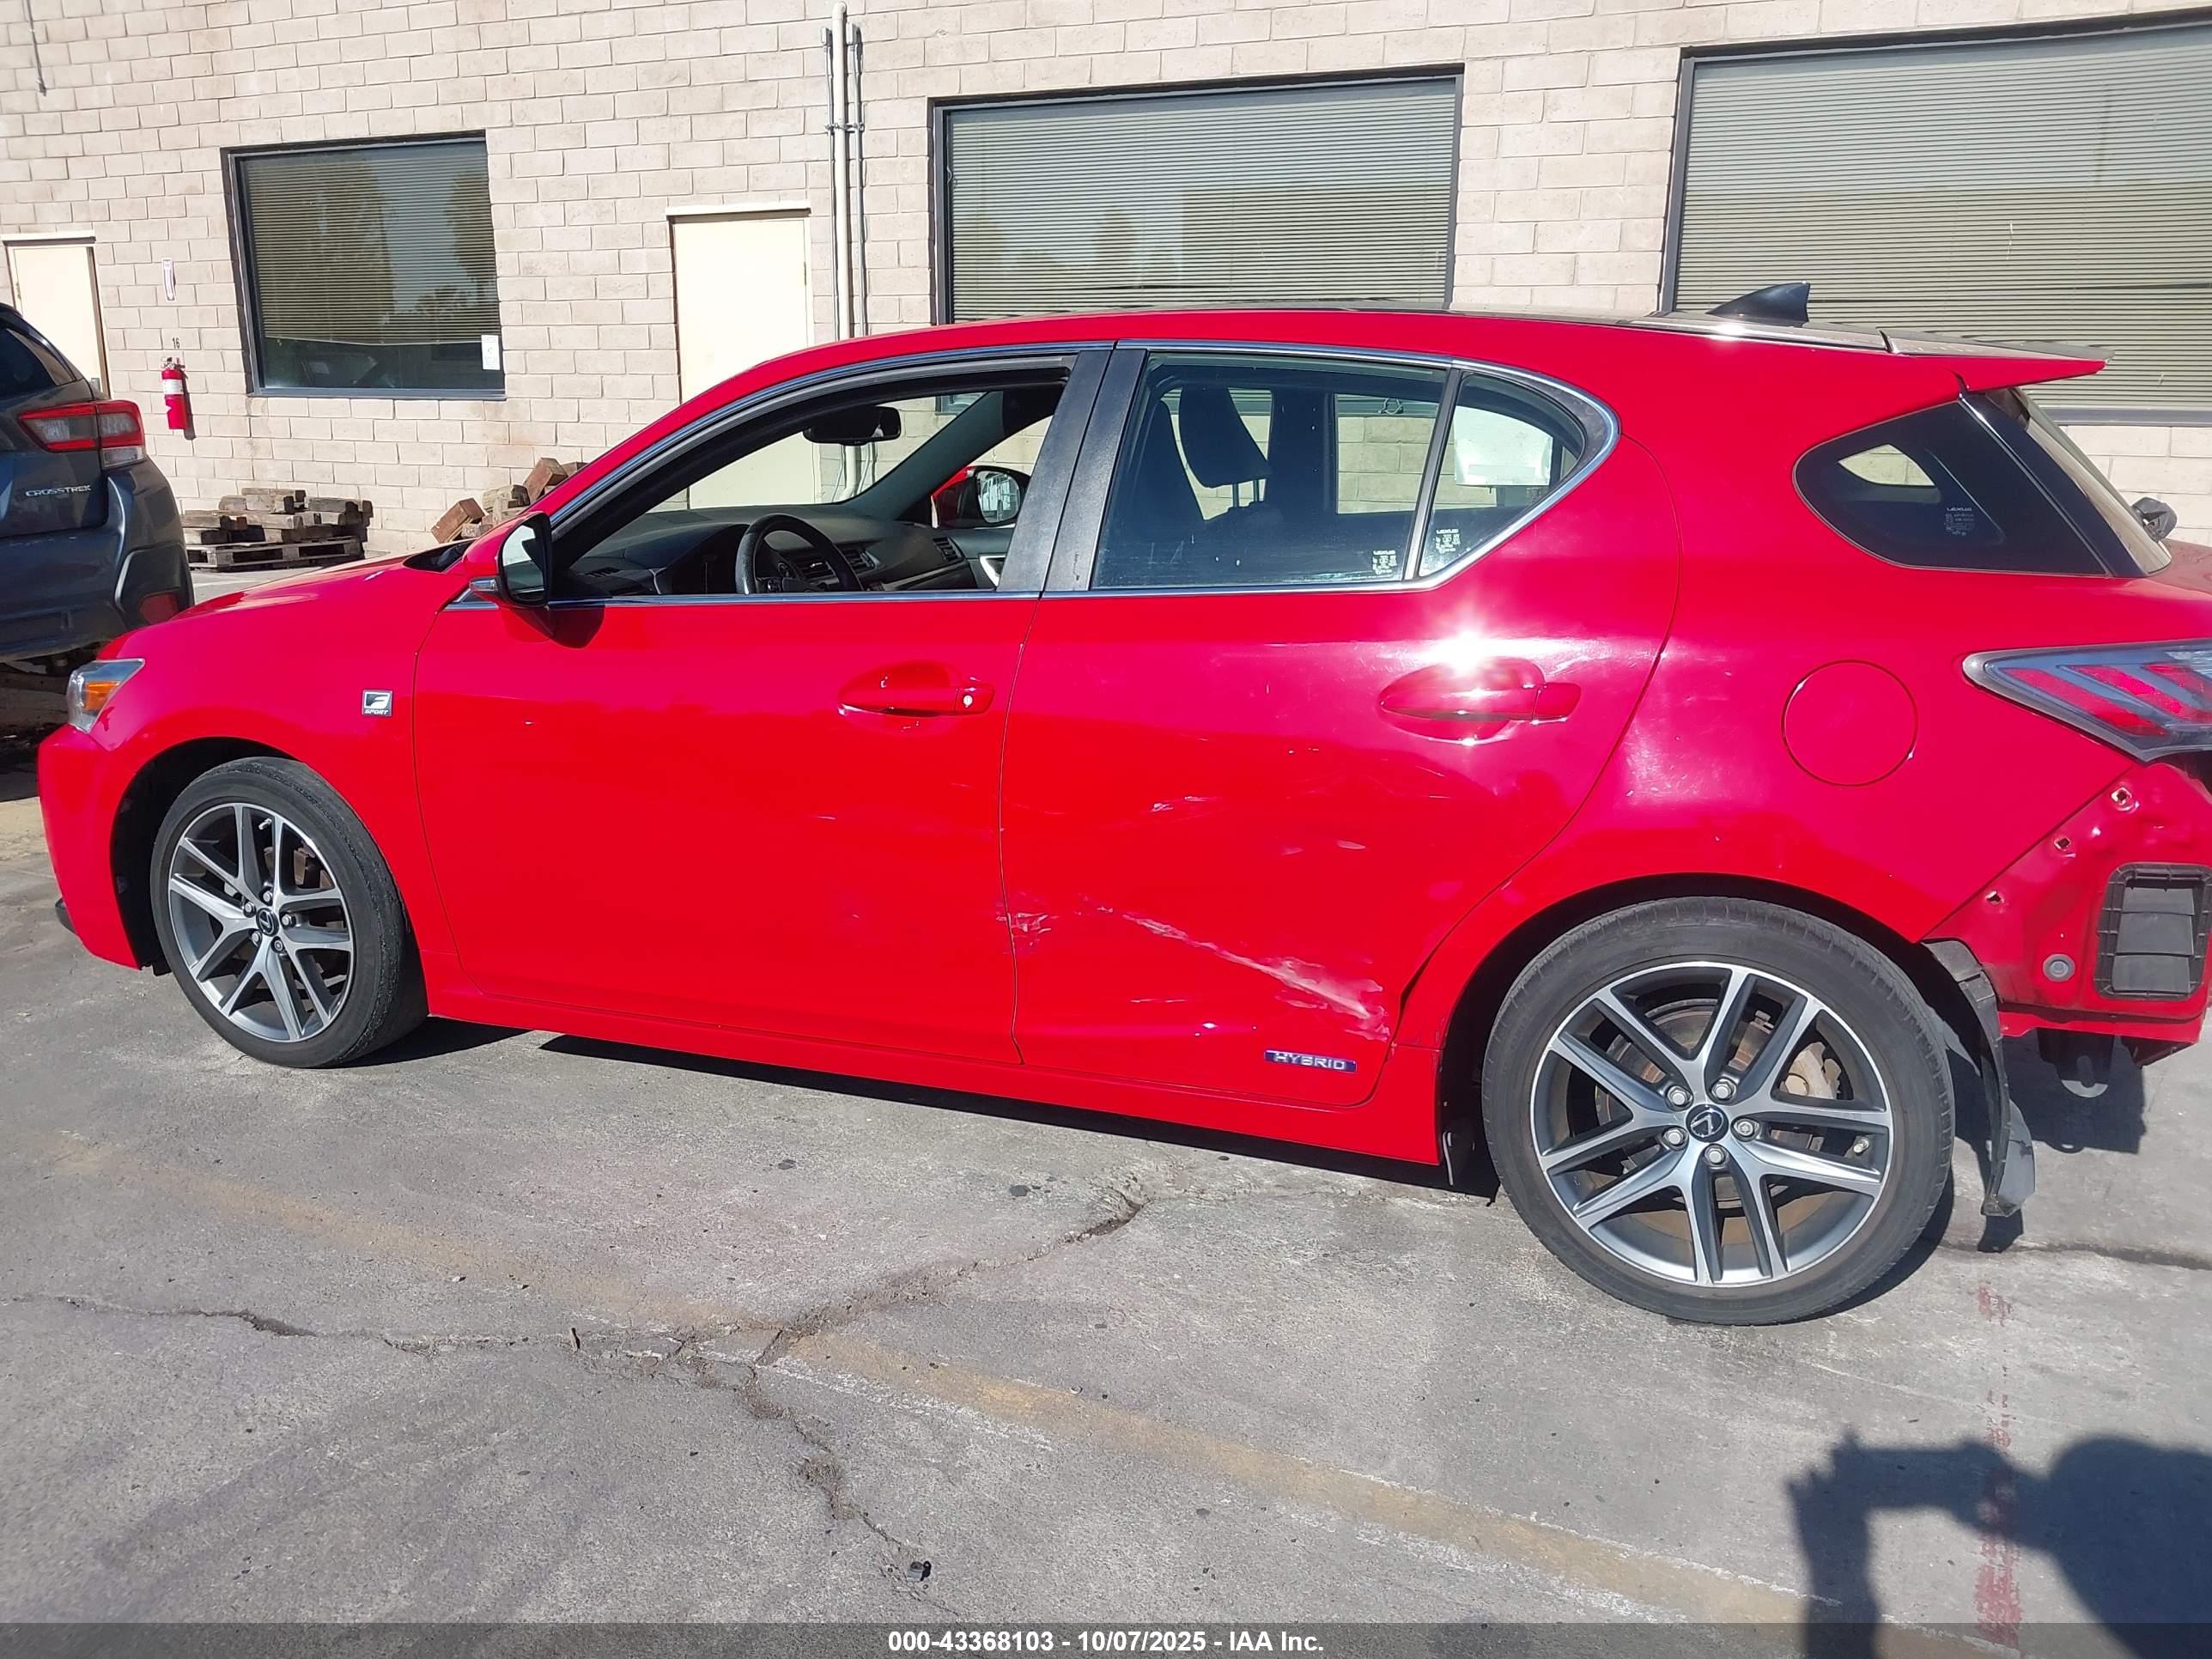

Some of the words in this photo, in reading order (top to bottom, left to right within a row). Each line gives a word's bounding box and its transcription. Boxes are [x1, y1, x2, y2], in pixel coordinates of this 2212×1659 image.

[172, 337, 180, 349] 16
[25, 484, 92, 497] CROSSTREK
[1273, 1052, 1346, 1071] HYBRID
